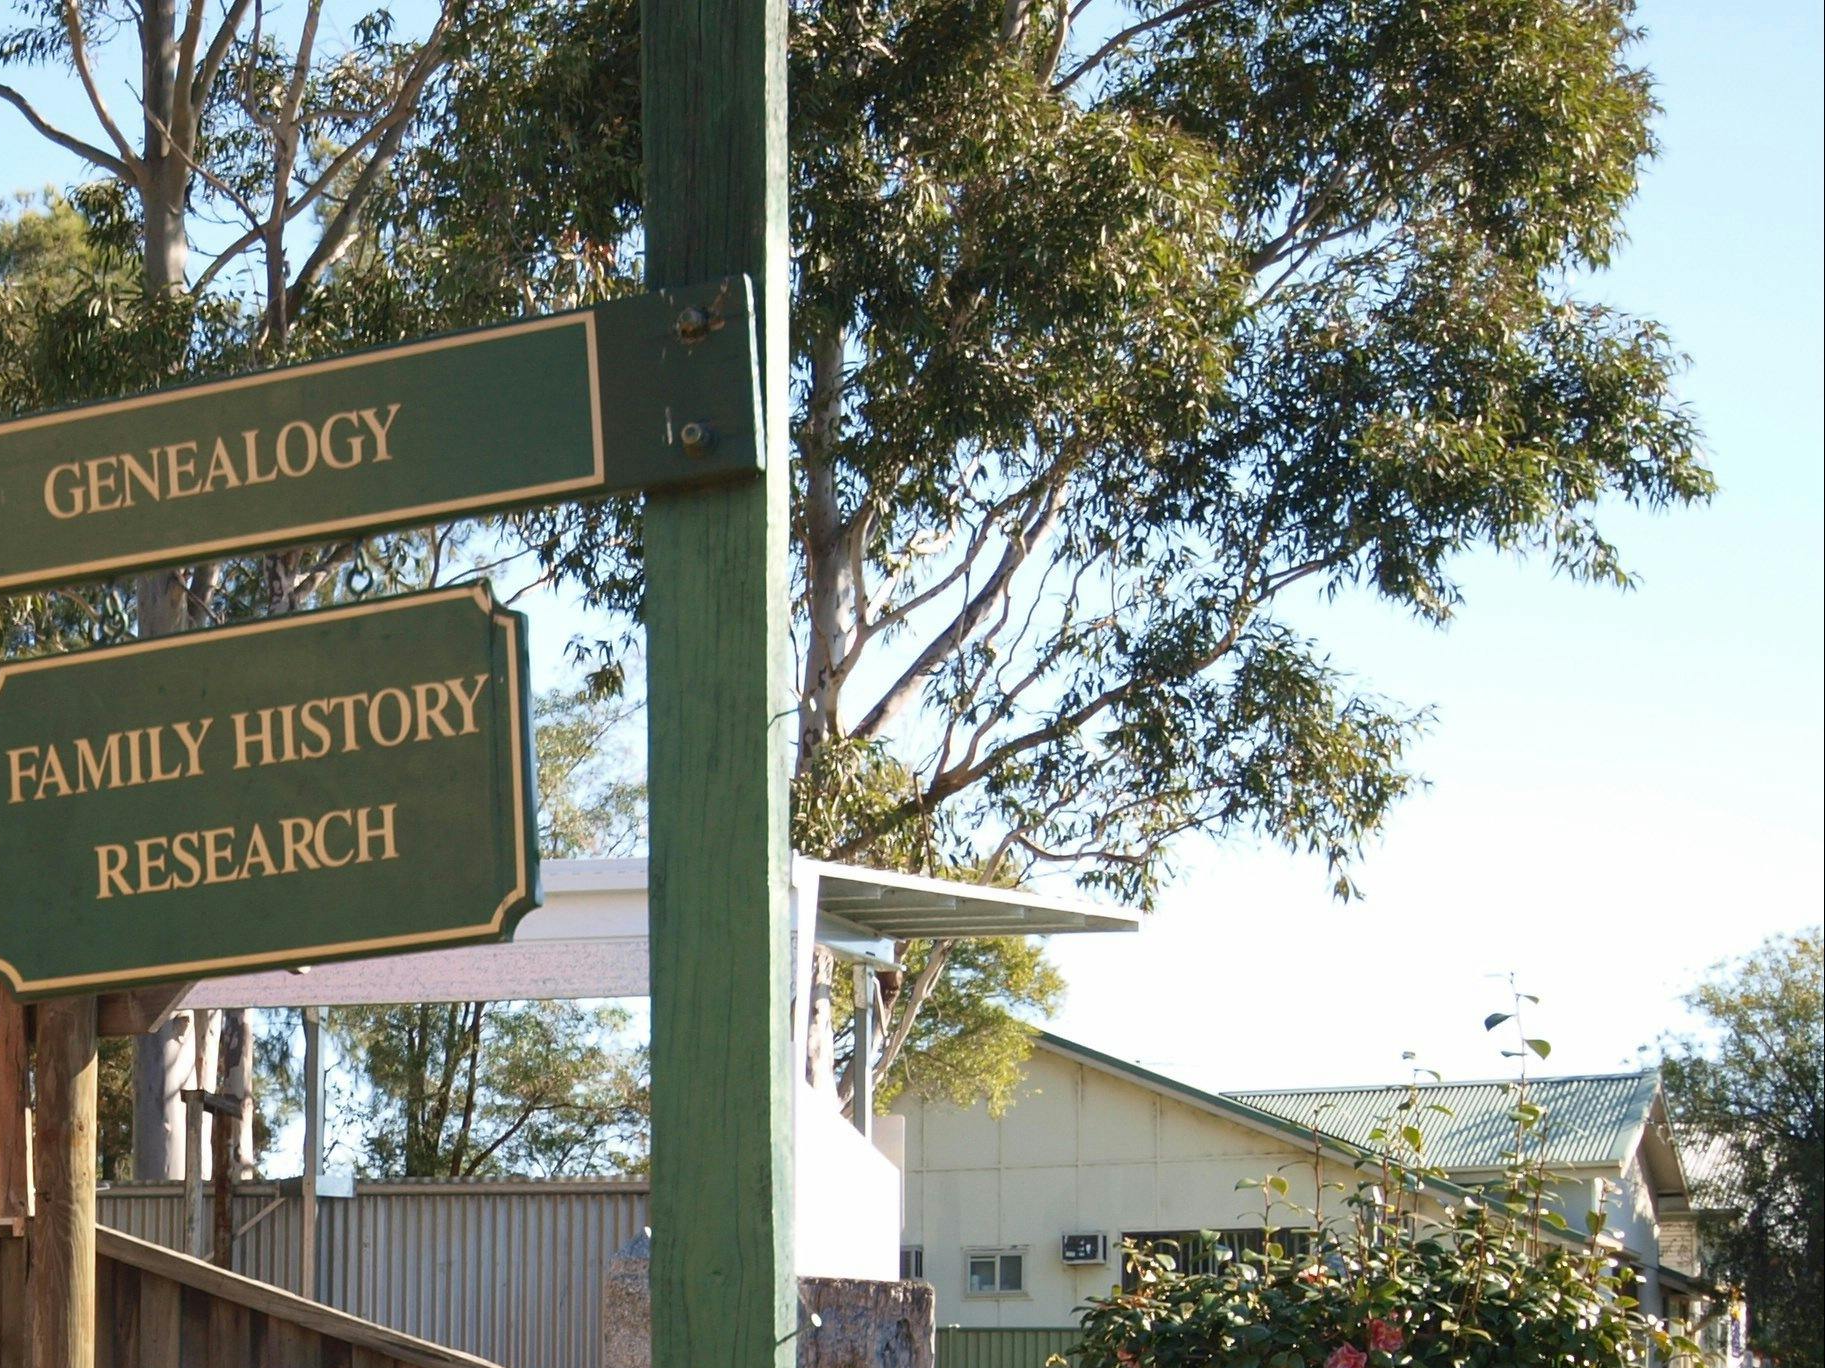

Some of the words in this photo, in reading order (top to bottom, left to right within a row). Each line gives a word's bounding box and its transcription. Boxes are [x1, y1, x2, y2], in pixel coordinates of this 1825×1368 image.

[43, 403, 402, 520] GENEALOGY
[6, 716, 213, 804] FAMILY
[231, 672, 489, 772] HISTORY
[93, 803, 400, 900] RESEARCH
